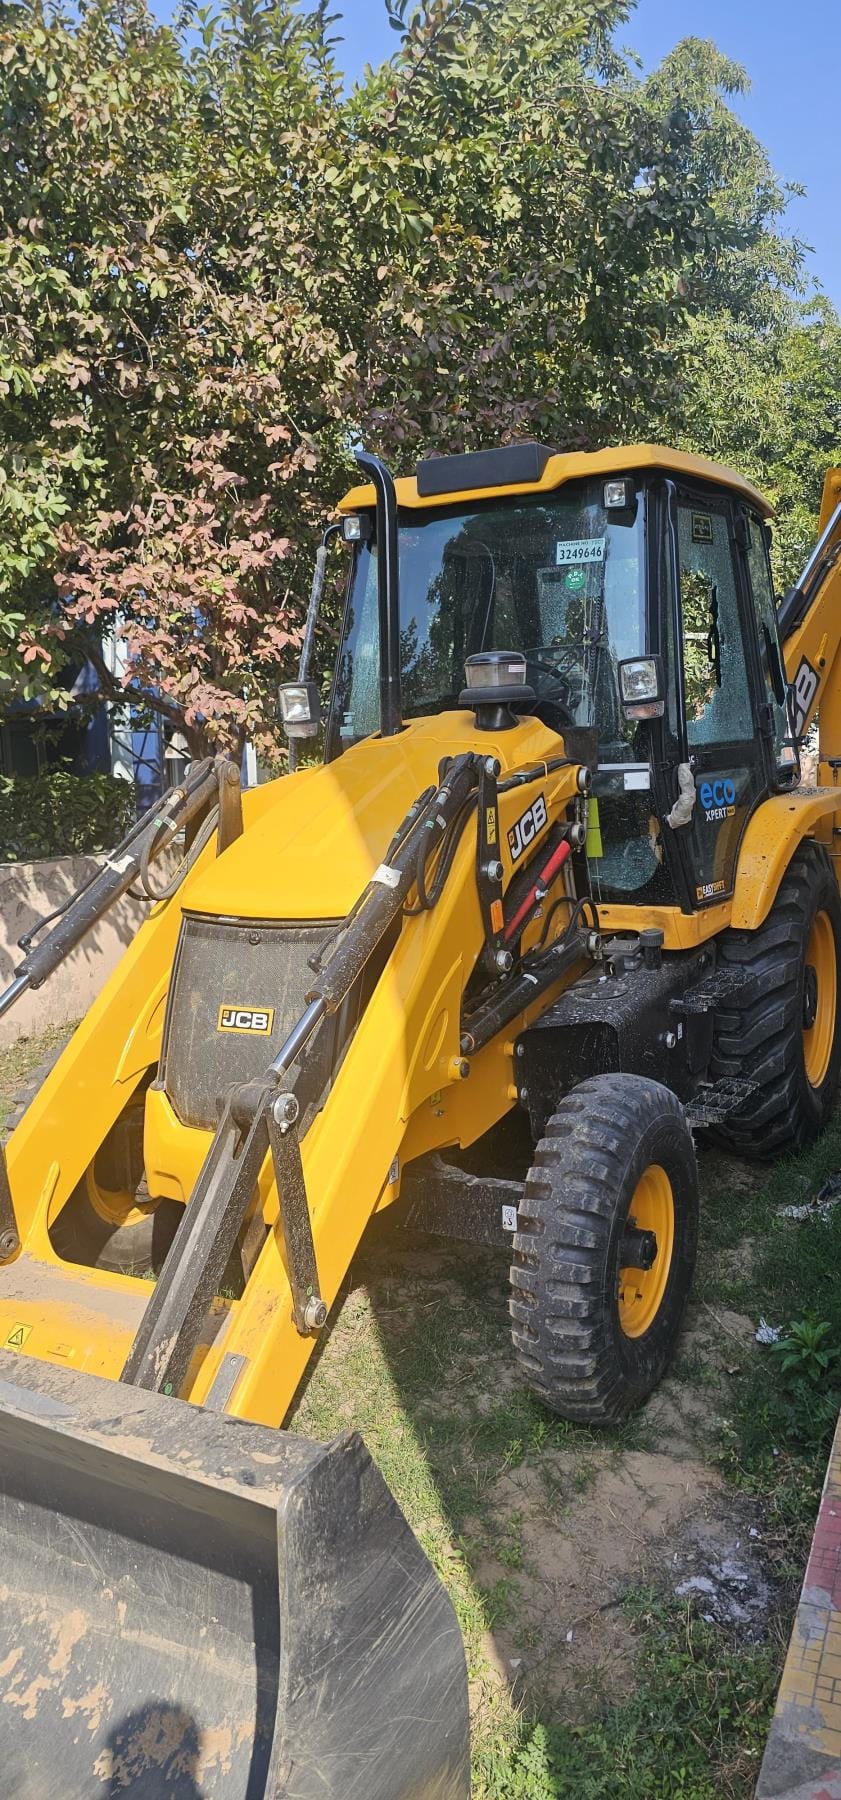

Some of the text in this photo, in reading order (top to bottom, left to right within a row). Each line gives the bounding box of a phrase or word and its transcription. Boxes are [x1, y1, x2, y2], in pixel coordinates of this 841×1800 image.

[559, 546, 602, 560] 3249646
[700, 778, 736, 809] eco
[705, 807, 727, 822] XPERT
[510, 796, 548, 860] JCB
[222, 1010, 268, 1030] JCB
